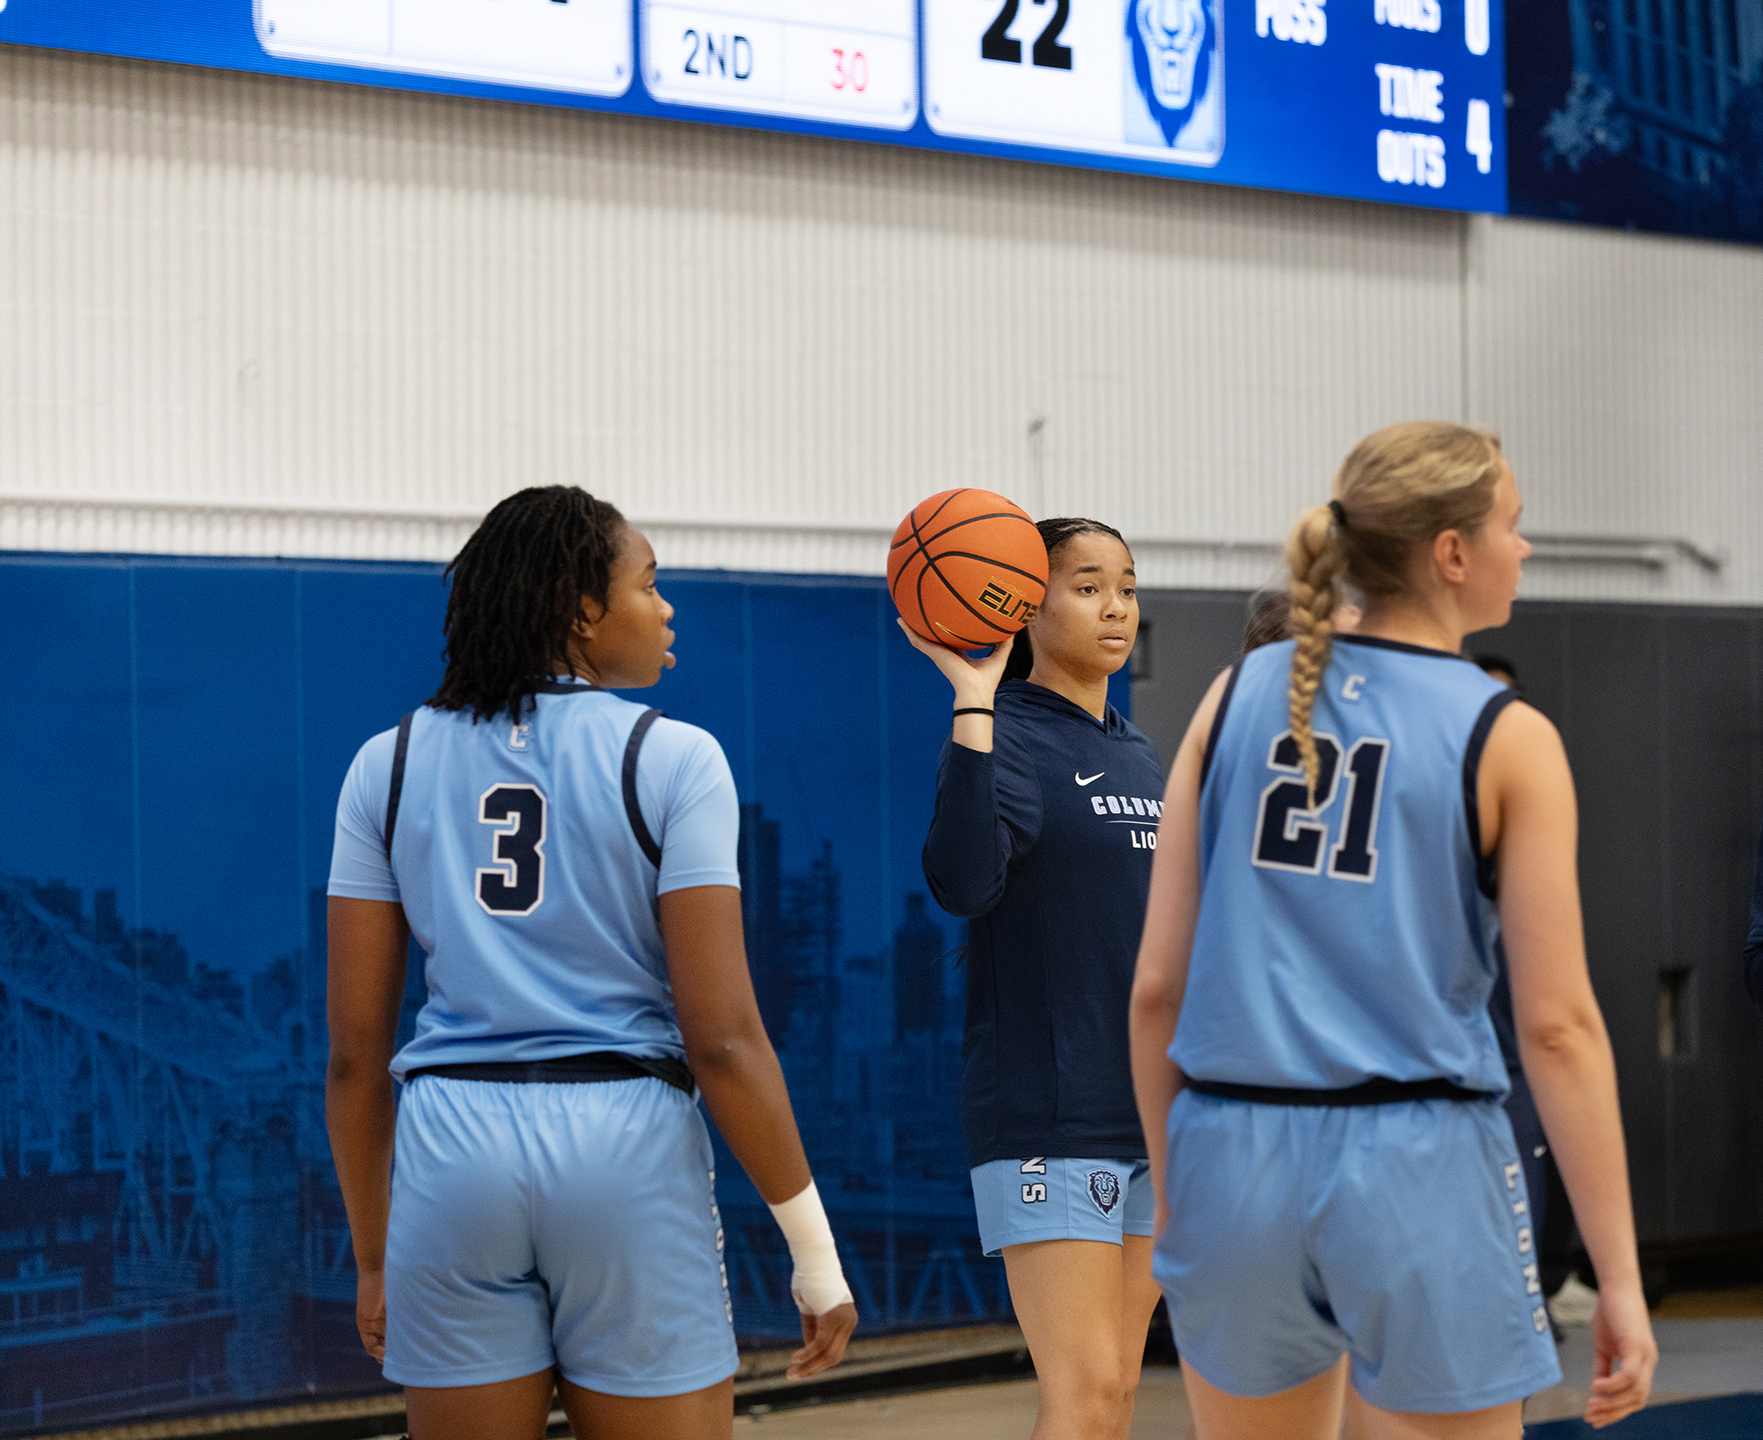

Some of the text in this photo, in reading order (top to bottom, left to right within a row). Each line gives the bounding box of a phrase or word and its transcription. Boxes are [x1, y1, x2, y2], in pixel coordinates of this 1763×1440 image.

[683, 29, 754, 80] 2ND
[982, 0, 1072, 70] 22
[831, 48, 869, 93] 30
[1375, 62, 1445, 124] TIME
[1377, 128, 1446, 189] OUTS
[1466, 98, 1492, 174] 4
[1341, 674, 1366, 701] C
[508, 723, 531, 750] C
[1090, 795, 1165, 818] COLUM
[1251, 729, 1391, 885] 21
[475, 782, 547, 917] 3
[1130, 829, 1160, 850] LIO
[1020, 1157, 1047, 1204] NS
